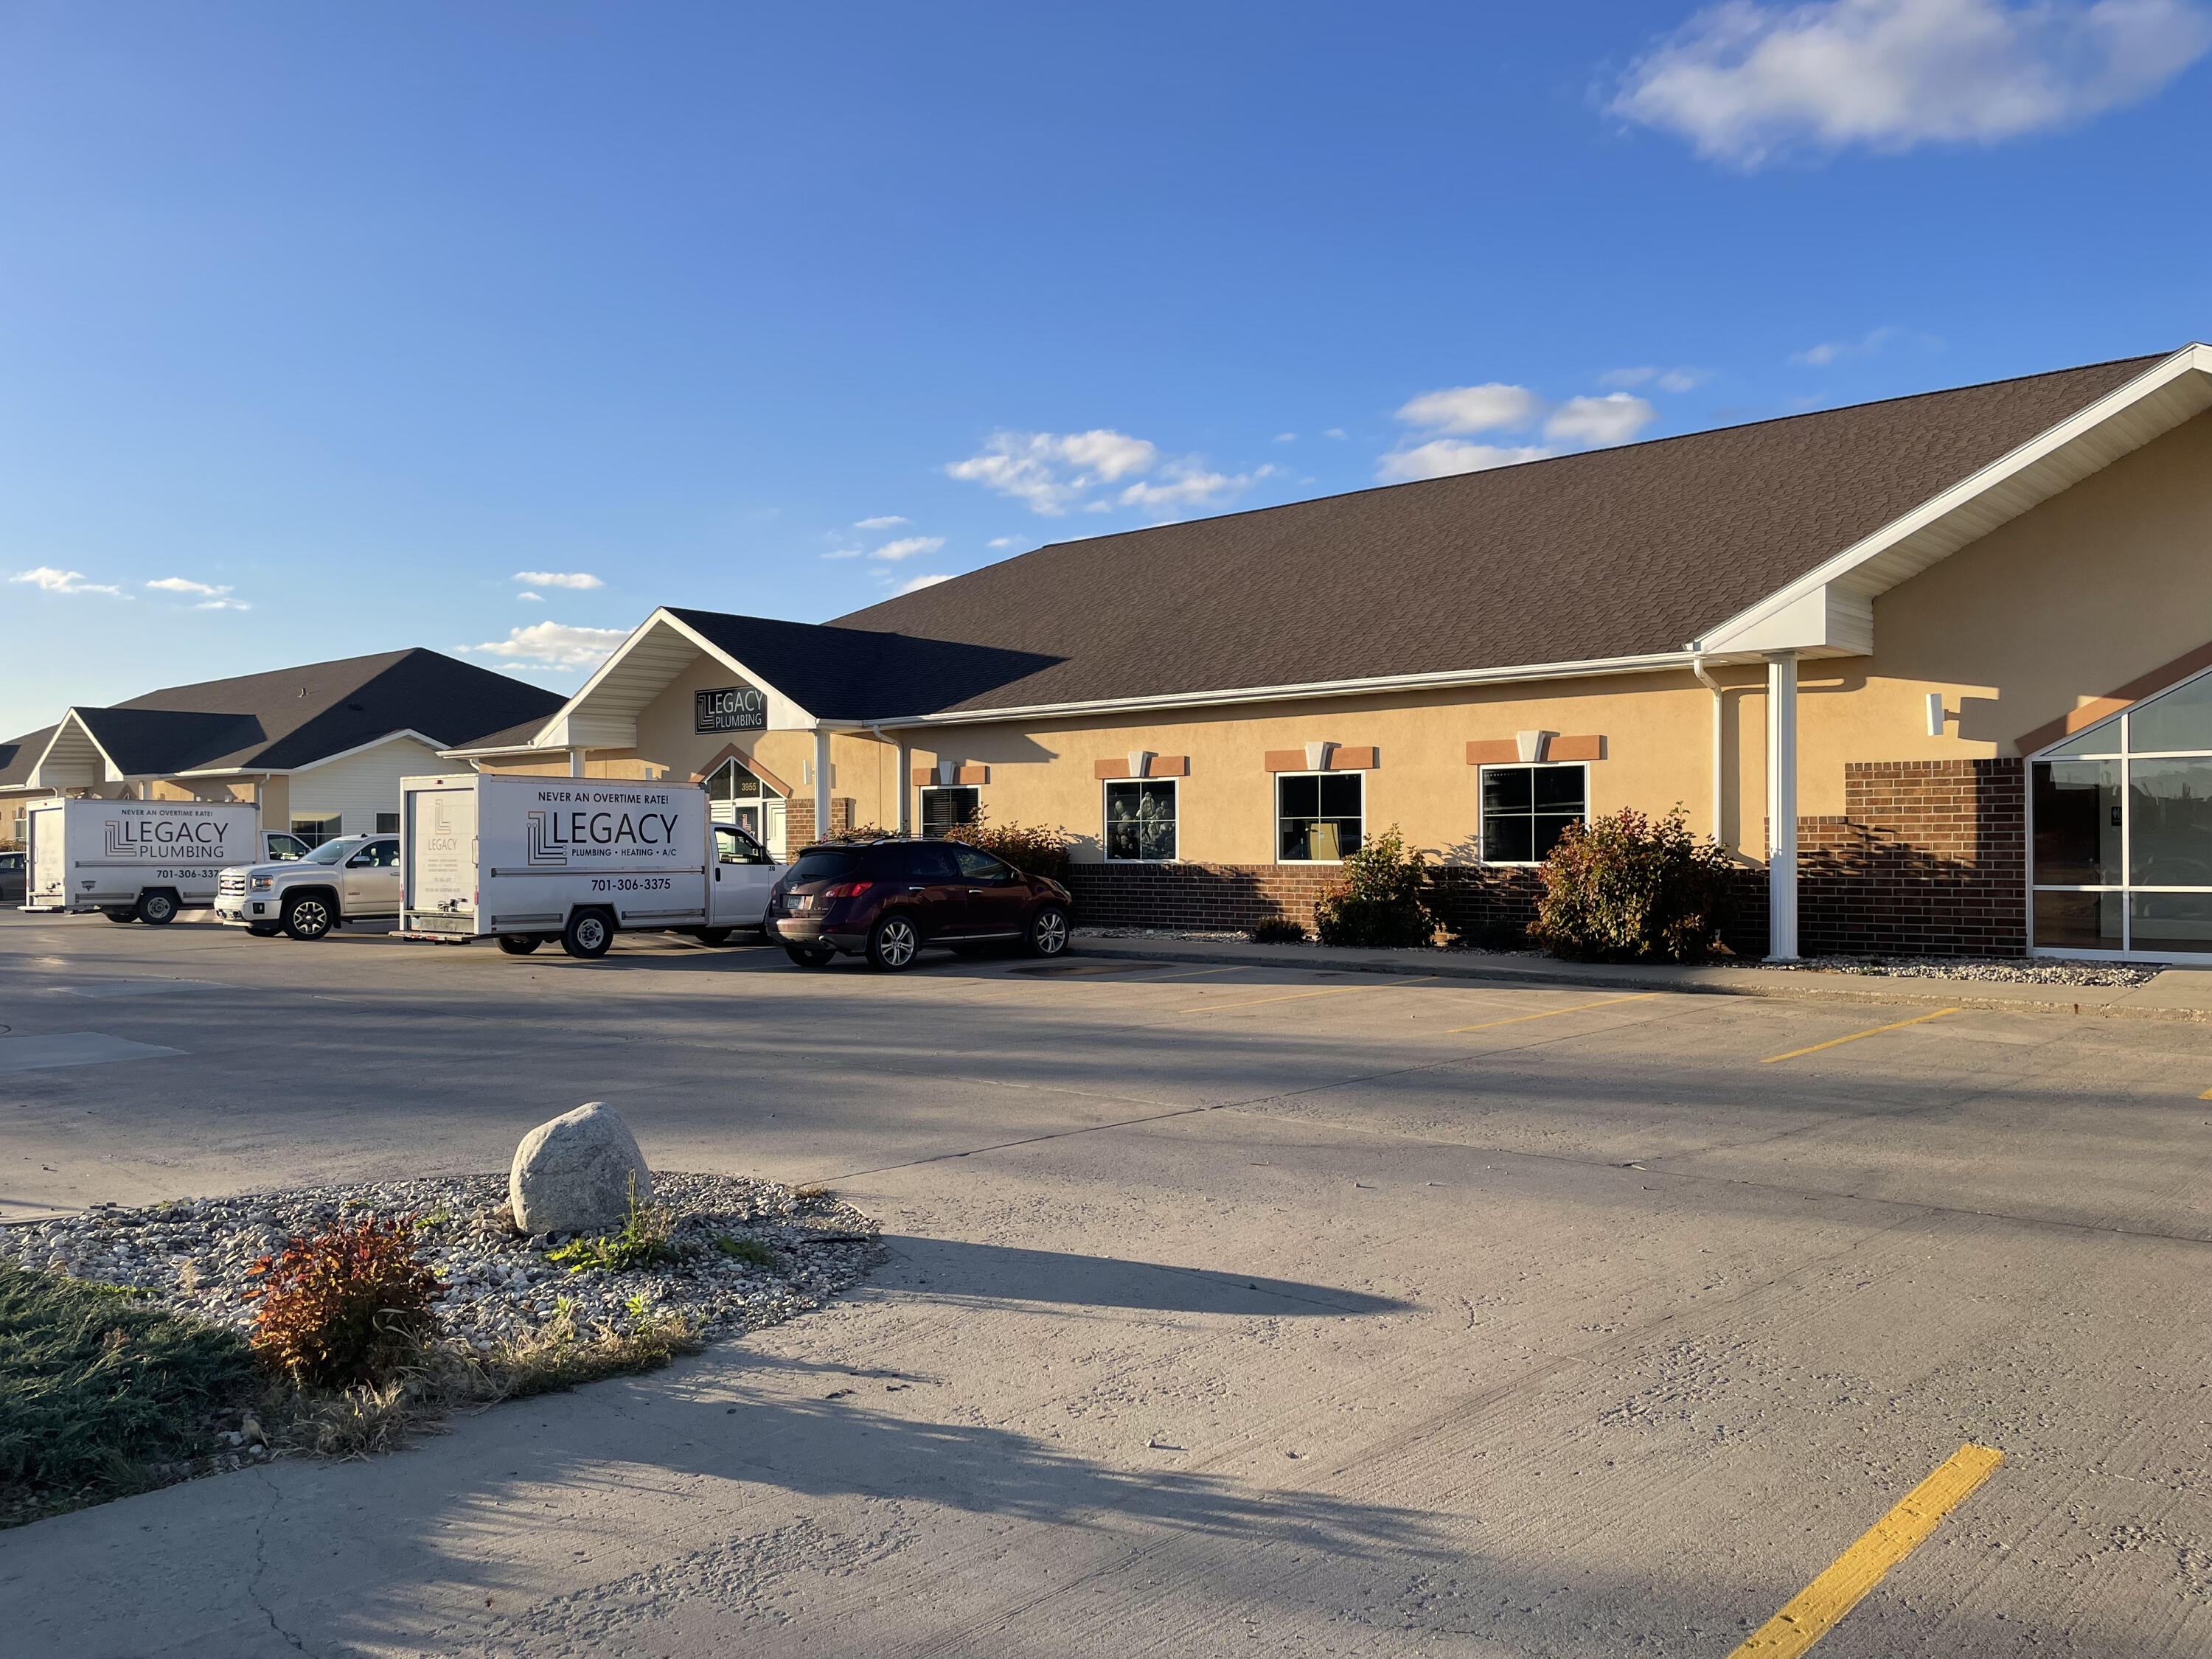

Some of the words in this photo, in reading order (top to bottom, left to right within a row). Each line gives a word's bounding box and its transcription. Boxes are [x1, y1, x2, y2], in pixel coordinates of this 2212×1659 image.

[708, 690, 763, 714] LEGACY
[716, 713, 762, 728] PLUMBING
[741, 782, 757, 791] 3955
[538, 791, 571, 801] NEVER
[575, 793, 590, 802] AN
[594, 793, 641, 804] OVERTIME
[644, 795, 669, 804] RATE!
[125, 821, 229, 843] LEGACY
[554, 812, 678, 844] LEGACY
[428, 838, 457, 851] LEGACY
[140, 845, 224, 858] PLUMBING
[571, 849, 611, 857] PLUMBING
[662, 849, 677, 857] A/C
[156, 870, 221, 878] 701-306-337
[591, 878, 671, 891] 701-306-3375
